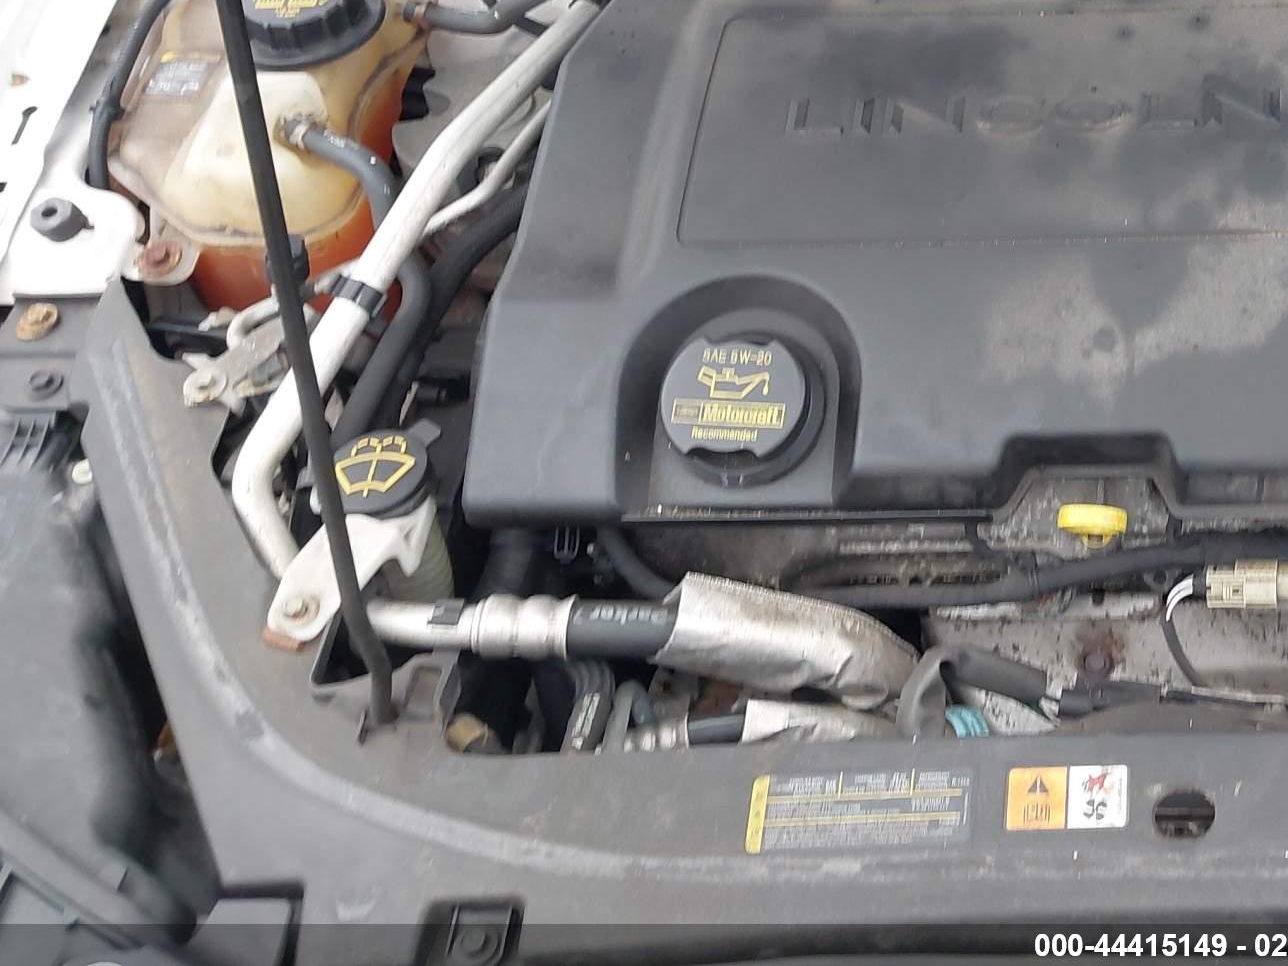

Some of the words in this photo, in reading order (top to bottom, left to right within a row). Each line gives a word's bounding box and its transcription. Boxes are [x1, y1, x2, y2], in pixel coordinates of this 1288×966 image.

[784, 89, 1282, 138] LINCOLN
[702, 402, 781, 426] Motorcraft
[691, 425, 758, 442] Recommended
[590, 604, 669, 626] Parker
